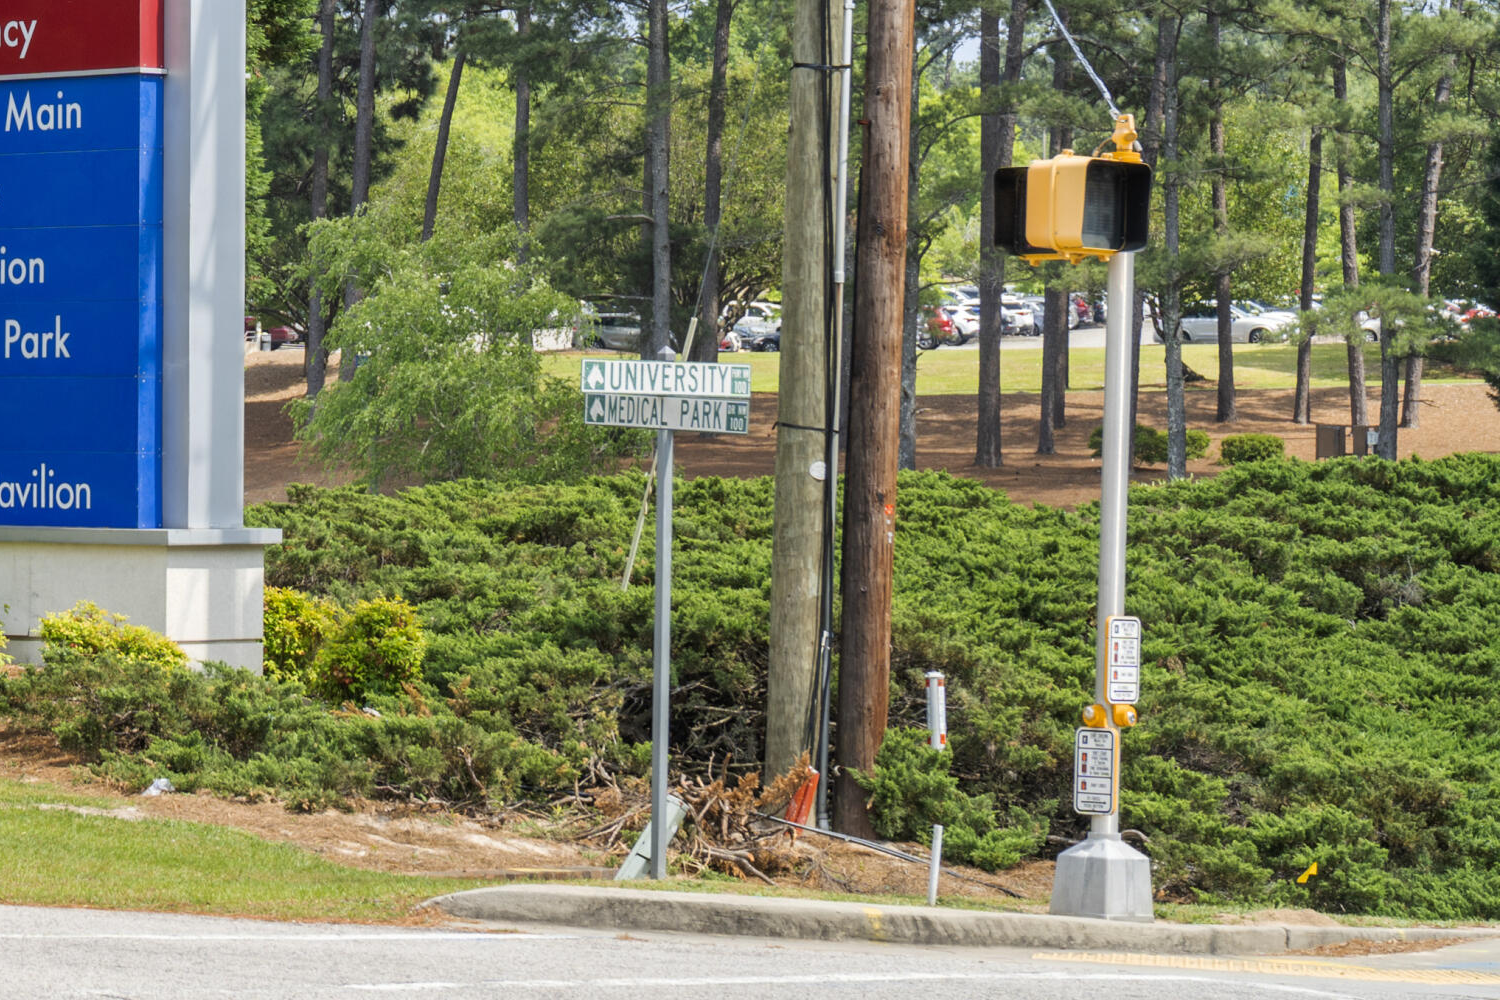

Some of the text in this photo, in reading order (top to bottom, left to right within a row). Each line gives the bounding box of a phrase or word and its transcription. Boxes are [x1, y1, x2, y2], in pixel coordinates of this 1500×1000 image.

[5, 91, 82, 132] Main
[5, 315, 71, 359] Park
[610, 362, 729, 393] UNIVERSITY
[734, 381, 747, 394] 100
[607, 396, 723, 429] MEDICAL PARK
[730, 417, 744, 431] 100
